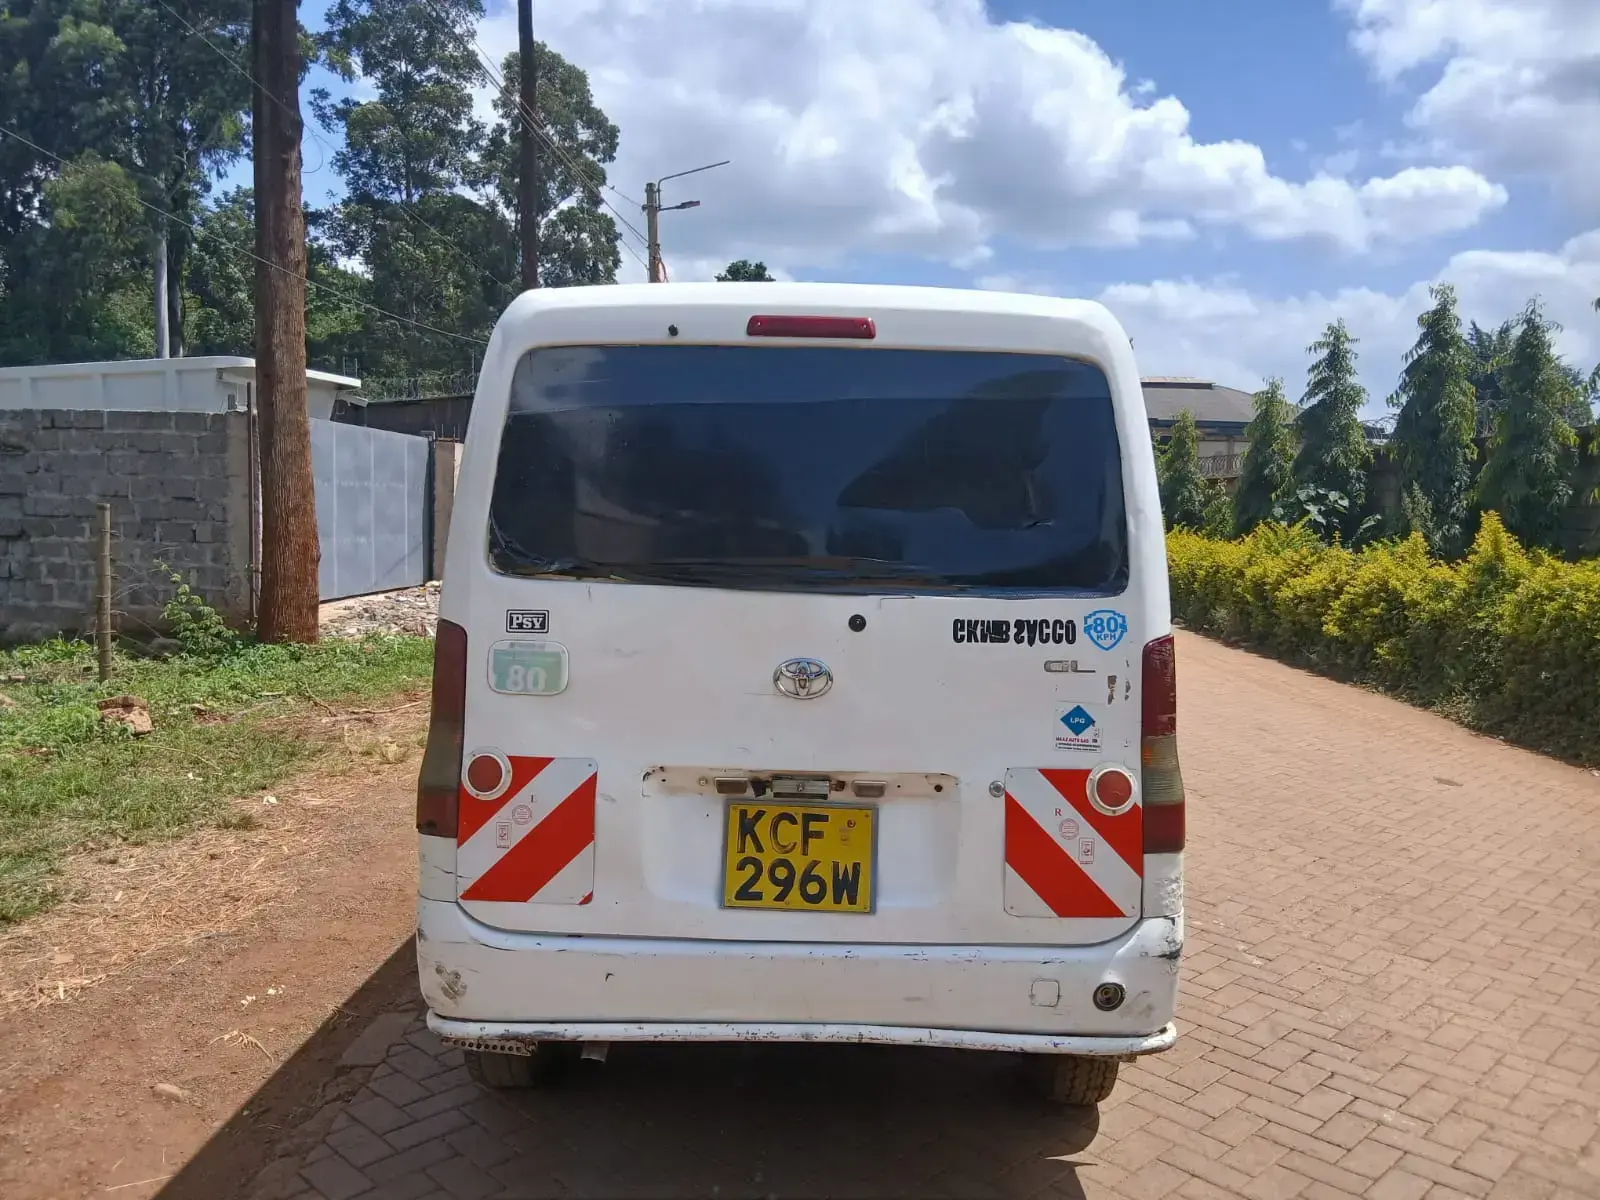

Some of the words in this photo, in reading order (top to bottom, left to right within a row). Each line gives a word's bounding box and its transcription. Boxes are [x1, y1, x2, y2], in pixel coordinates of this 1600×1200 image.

[1093, 616, 1119, 634] 80
[1096, 633, 1117, 641] KPH
[506, 664, 547, 692] 80
[1055, 808, 1062, 817] R
[736, 808, 830, 857] KCF
[734, 856, 861, 906] 296W
